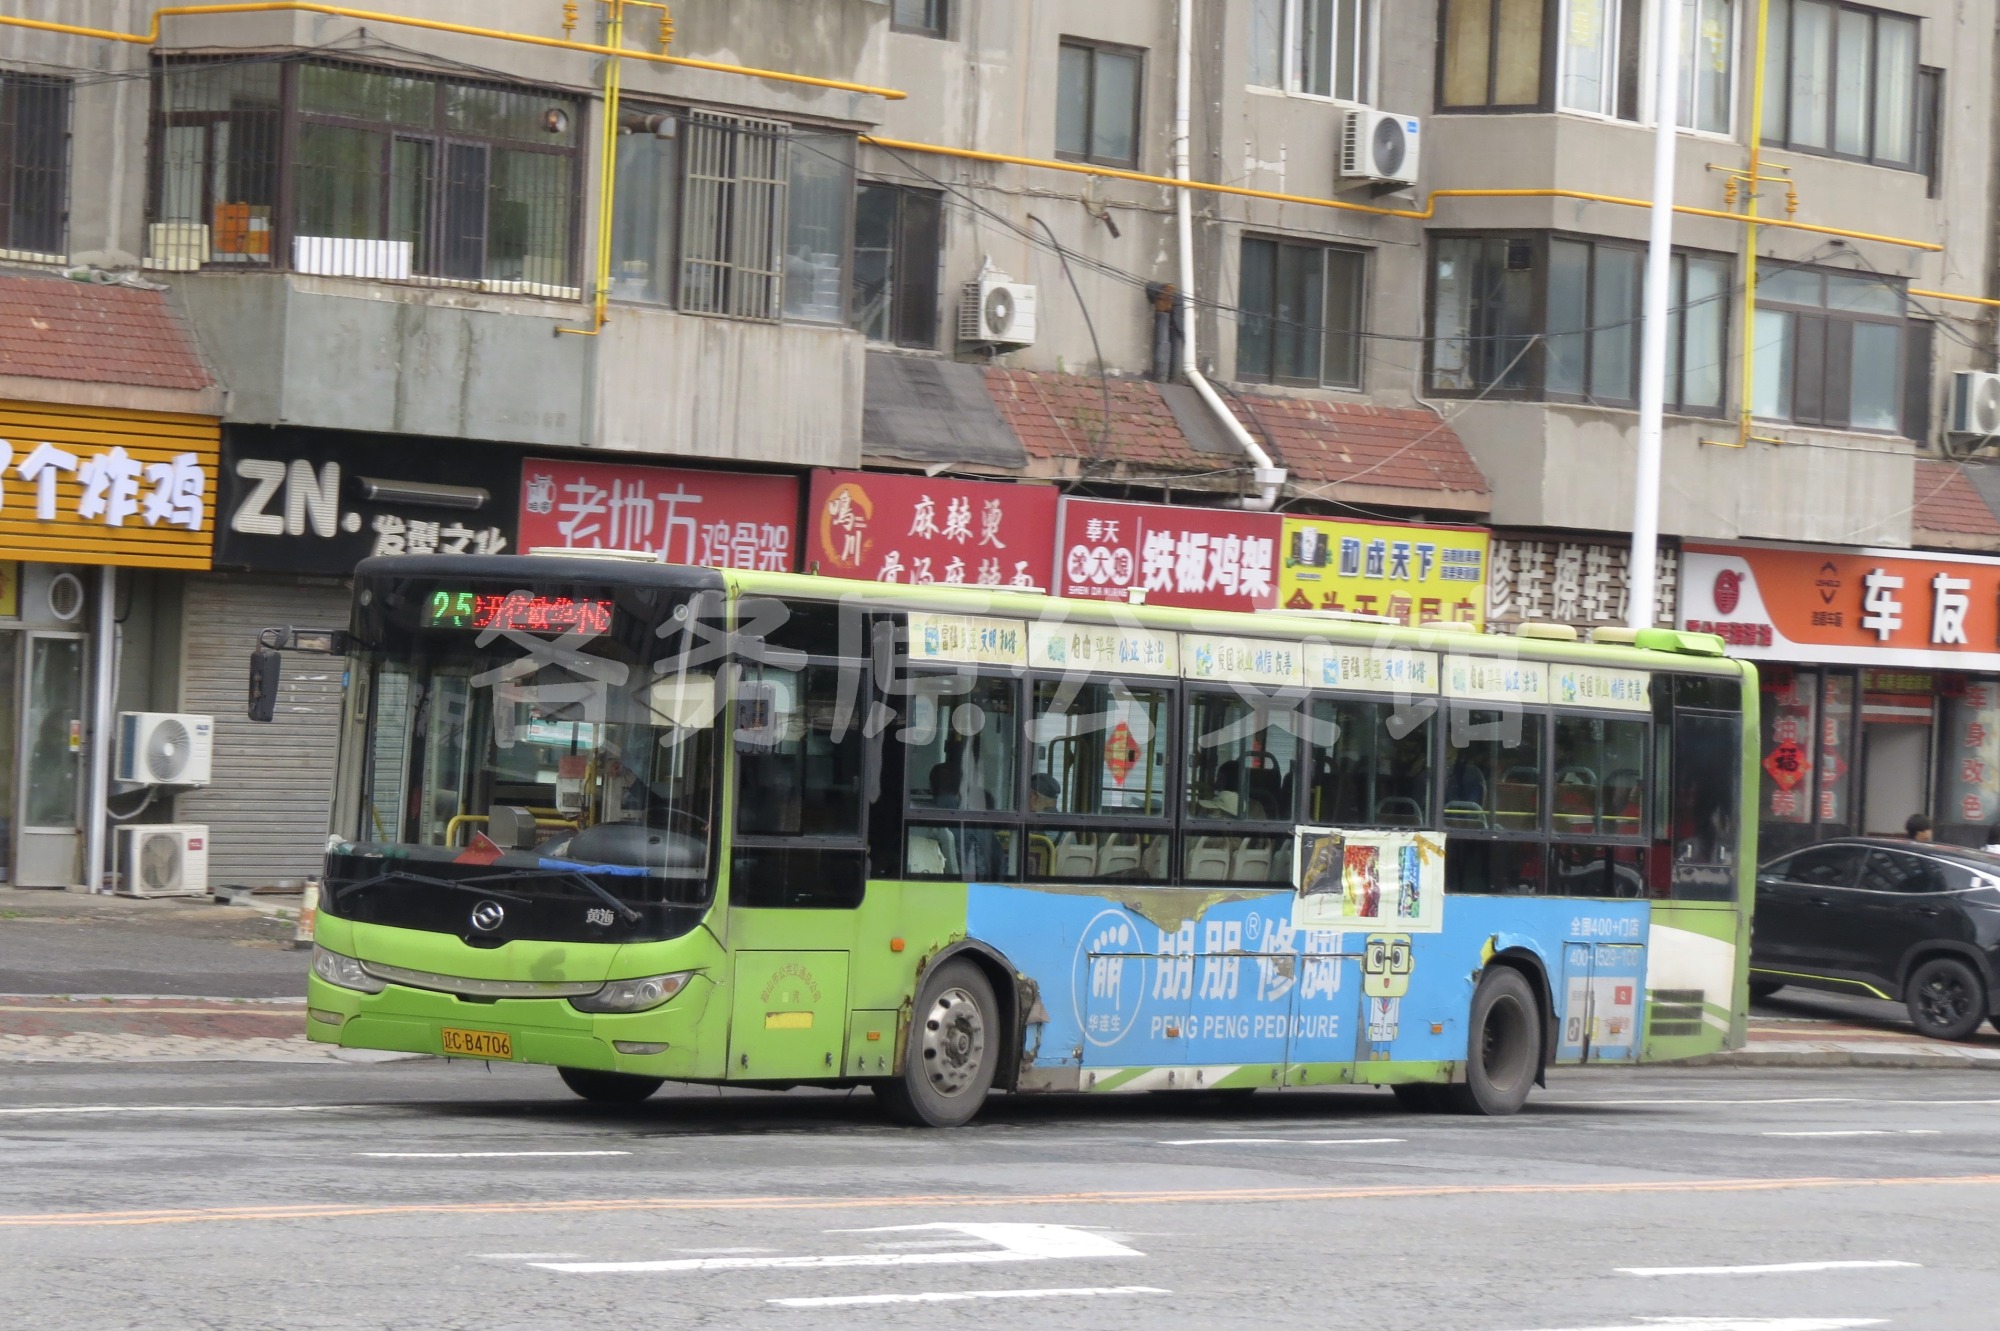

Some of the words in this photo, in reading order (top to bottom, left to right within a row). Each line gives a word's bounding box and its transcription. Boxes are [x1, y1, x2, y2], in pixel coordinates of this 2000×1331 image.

[0, 439, 206, 531] 个炸鸡
[557, 477, 704, 566] 老地方
[700, 519, 790, 572] 鸡骨架
[907, 494, 1007, 549] 麻辣烫
[1086, 518, 1120, 543] 奉天
[1070, 549, 1130, 580] 沈大娘
[1142, 530, 1274, 597] 铁板鸡架
[1068, 585, 1089, 595] SHEN
[433, 591, 473, 627] 25
[1862, 568, 1971, 644] 车友
[586, 908, 614, 926] 黄海
[1571, 916, 1640, 937] 全国400+门店
[1088, 1013, 1121, 1032] 华连生
[1151, 1015, 1199, 1039] PENG
[1203, 1015, 1249, 1039] PENG
[1254, 1015, 1339, 1039] PEDICURE
